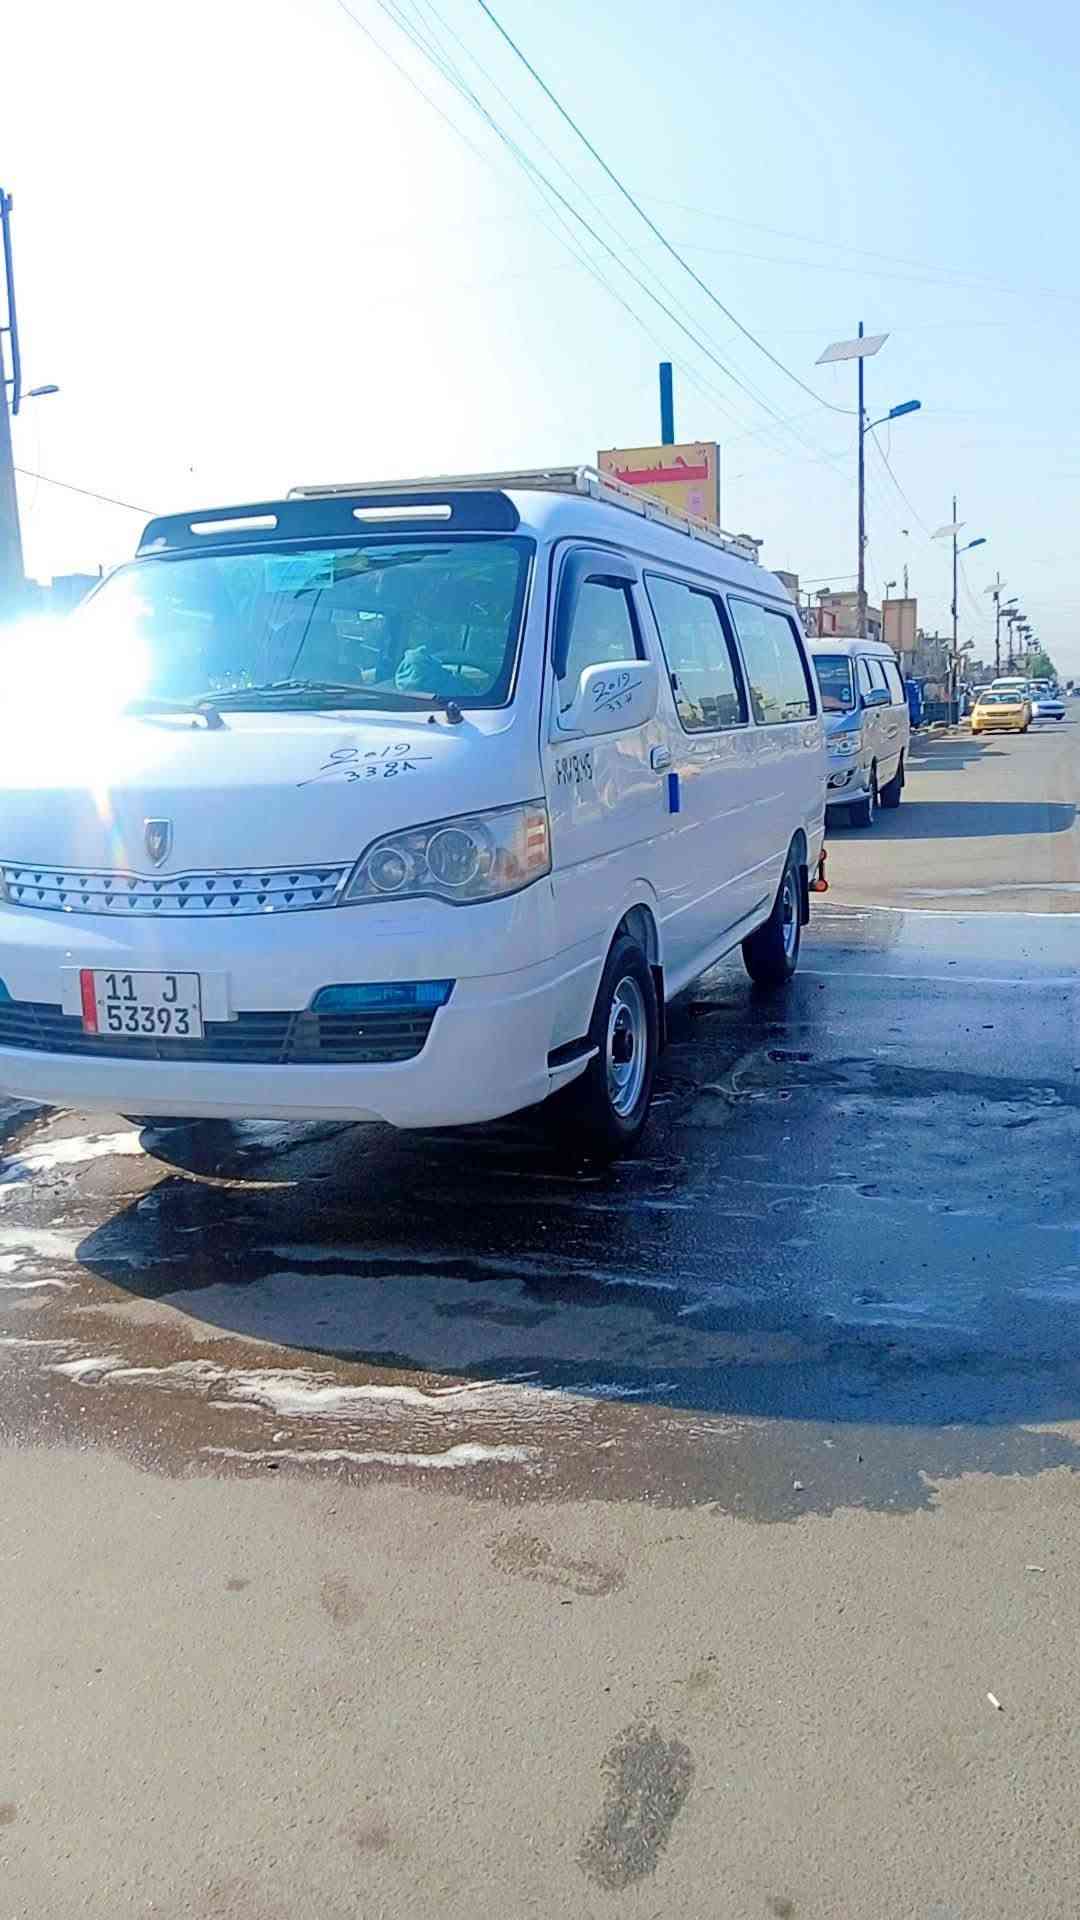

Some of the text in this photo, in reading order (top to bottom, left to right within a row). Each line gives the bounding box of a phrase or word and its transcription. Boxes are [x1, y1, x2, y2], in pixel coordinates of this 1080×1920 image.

[105, 973, 178, 1003] 11 J
[106, 1004, 190, 1035] 53393
